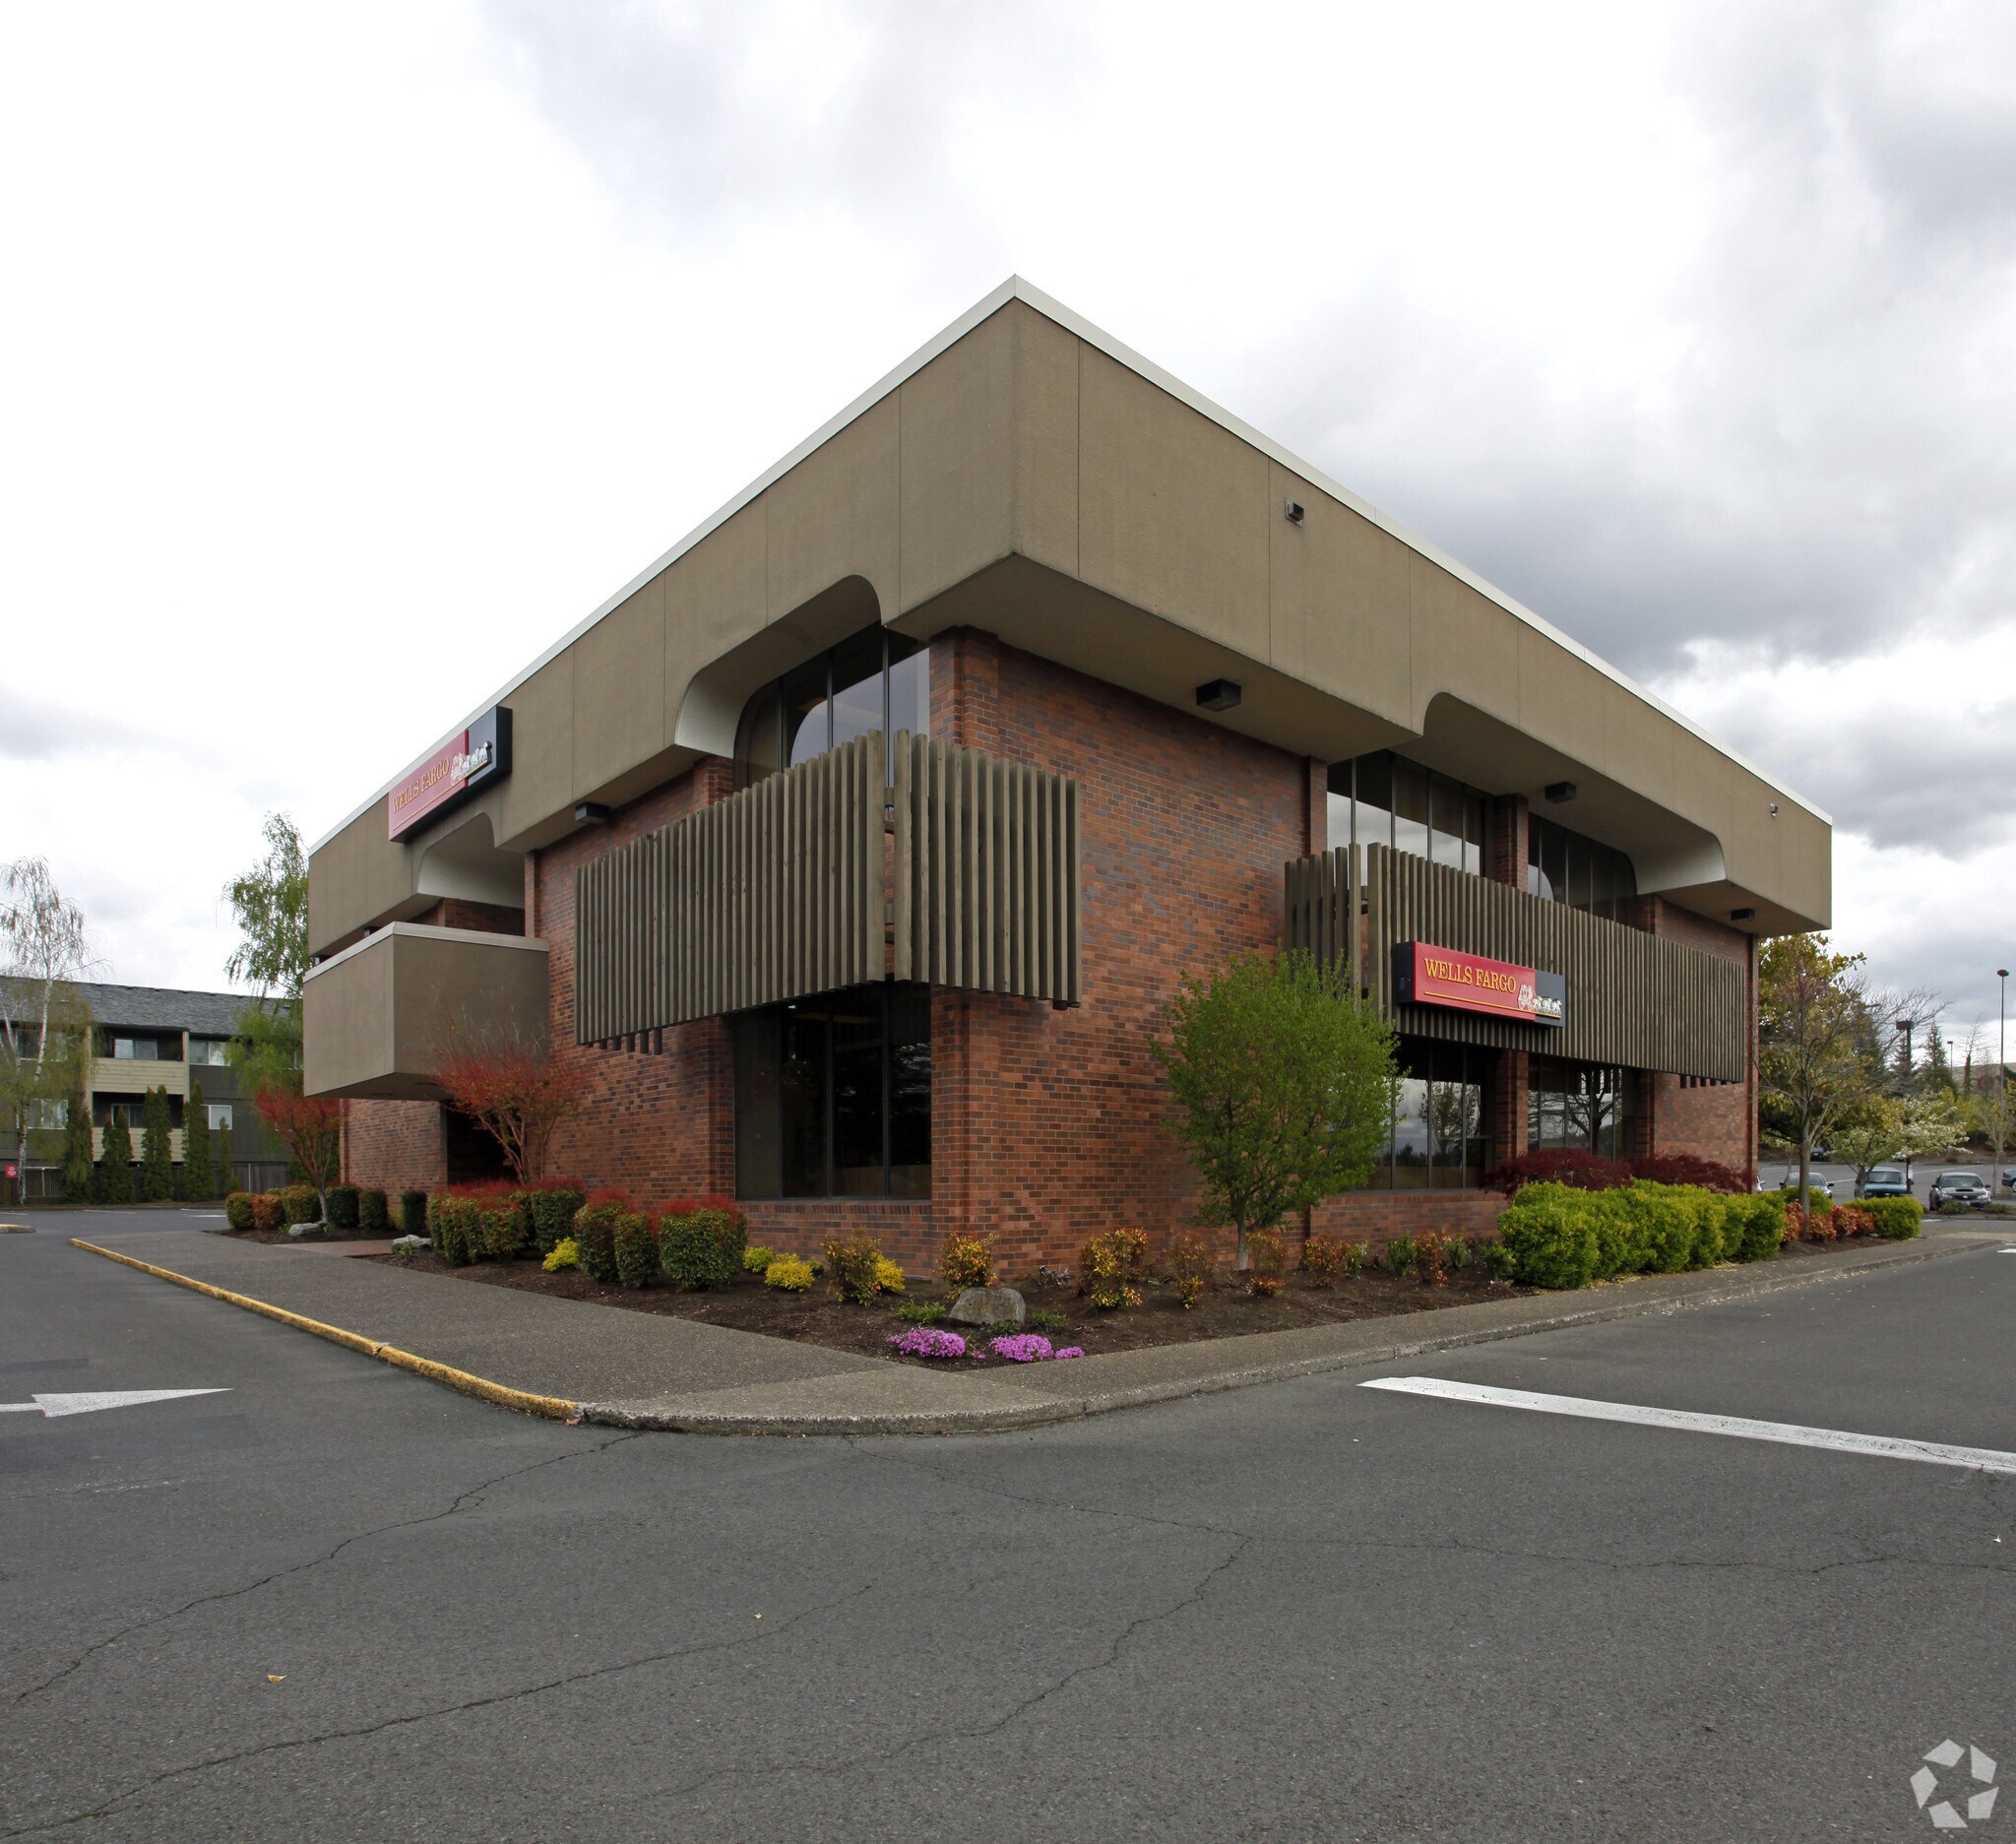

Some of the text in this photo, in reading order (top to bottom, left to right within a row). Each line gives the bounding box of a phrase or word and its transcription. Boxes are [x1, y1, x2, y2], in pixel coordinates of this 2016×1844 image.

[393, 756, 450, 813] WELLS FARGO
[1423, 958, 1516, 993] WELLS FARGO
